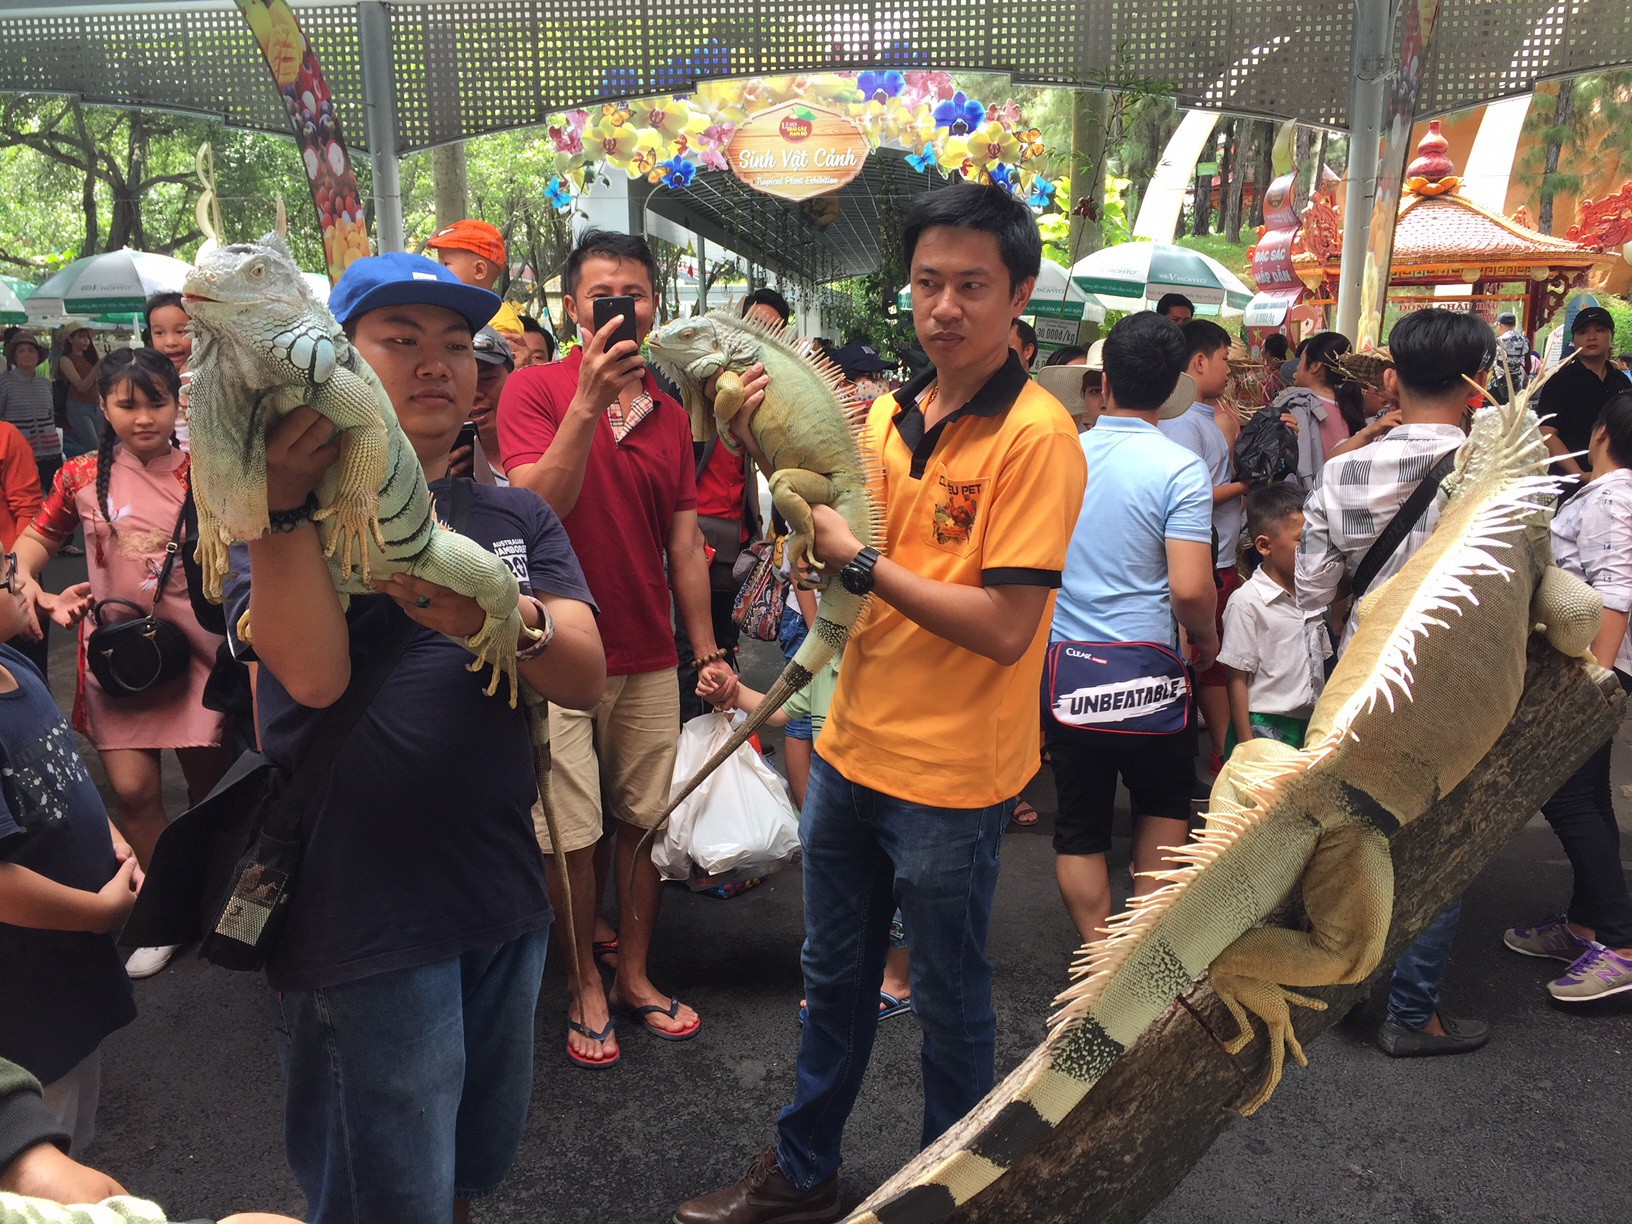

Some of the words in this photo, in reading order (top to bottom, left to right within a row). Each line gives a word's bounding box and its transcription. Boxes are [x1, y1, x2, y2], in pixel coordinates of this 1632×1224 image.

[739, 149, 776, 169] Sinh
[781, 149, 808, 171] Vật
[814, 147, 857, 167] Cảnh
[756, 177, 784, 186] Tropical
[785, 177, 805, 185] Plant
[805, 176, 838, 185] Exhibition
[961, 484, 981, 495] PET
[1066, 647, 1092, 660] CLEAR
[1070, 680, 1180, 715] UNBEATABLE
